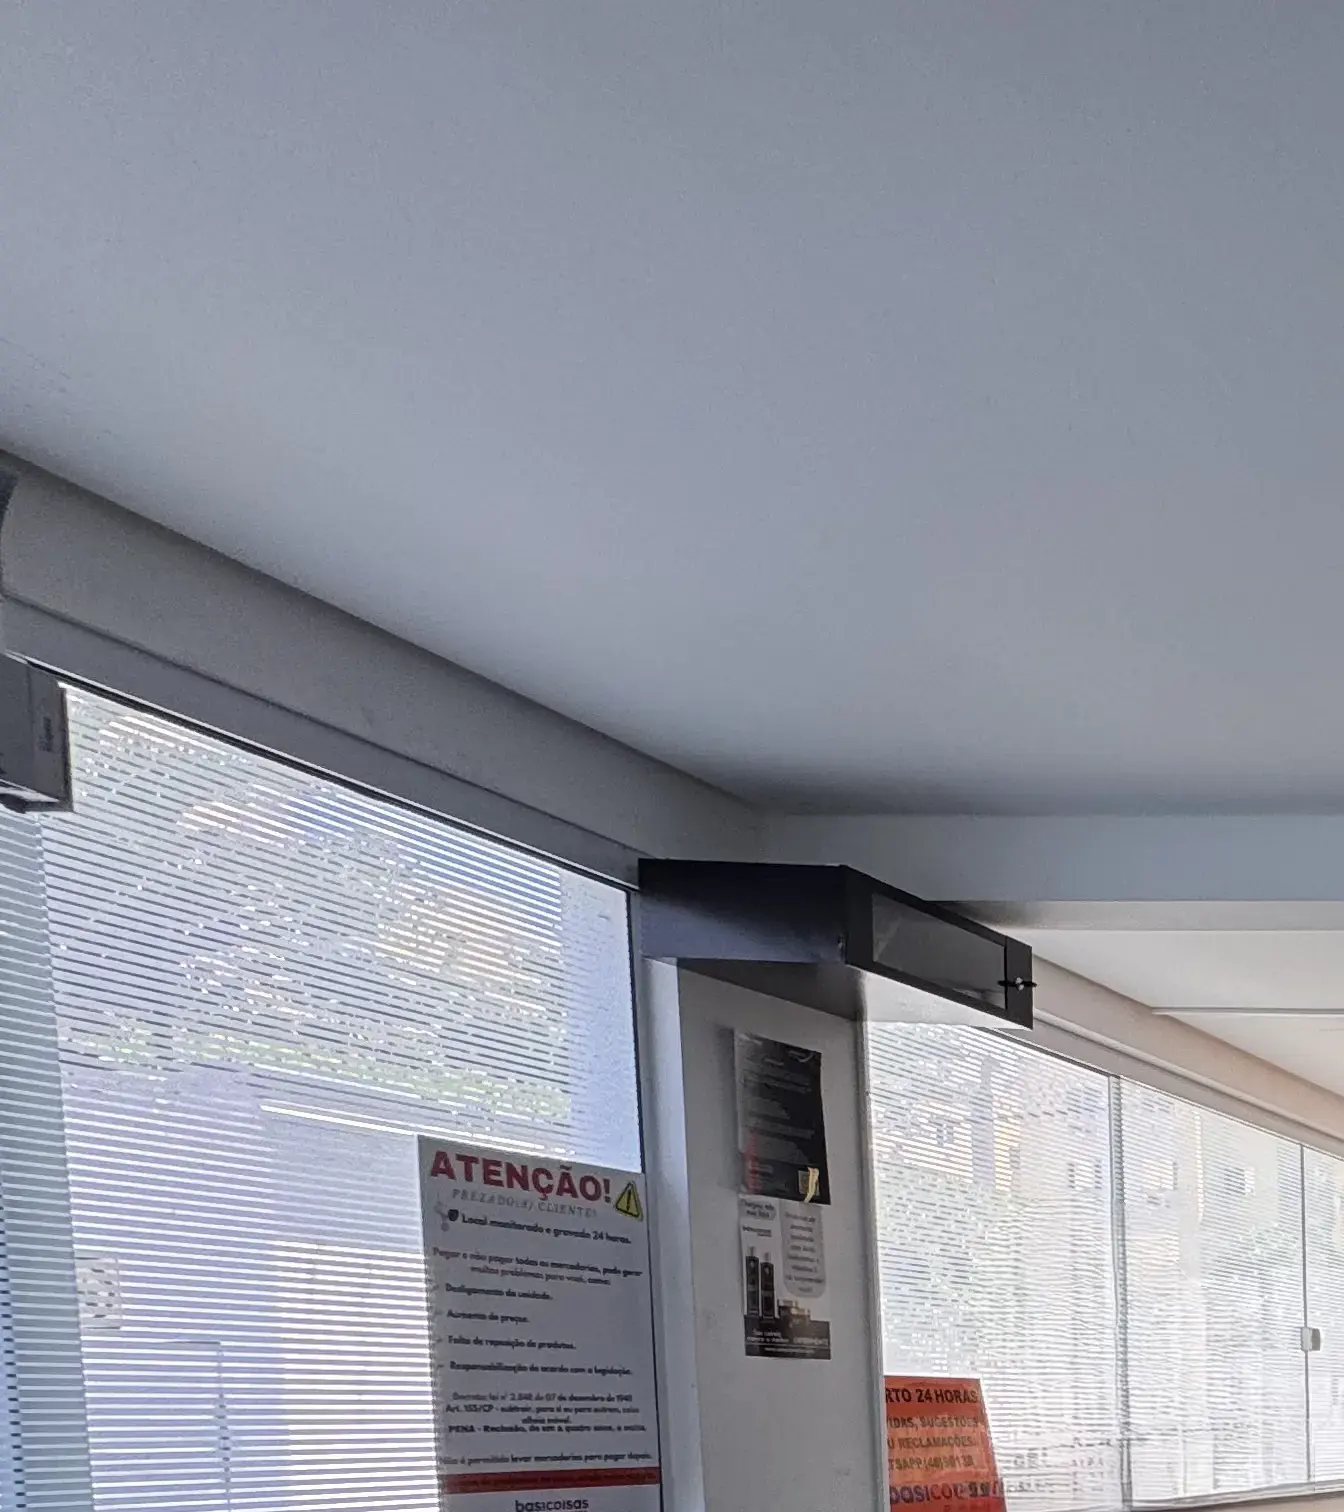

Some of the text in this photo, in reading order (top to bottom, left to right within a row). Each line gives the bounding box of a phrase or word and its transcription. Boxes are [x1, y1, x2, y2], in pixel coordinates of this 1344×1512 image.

[431, 1150, 611, 1203] ATENÇÃO!
[462, 1213, 487, 1225] Local
[593, 1230, 603, 1241] 24
[915, 1388, 932, 1402] 24
[934, 1388, 978, 1403] HORAS
[515, 1499, 589, 1512] basicoisas
